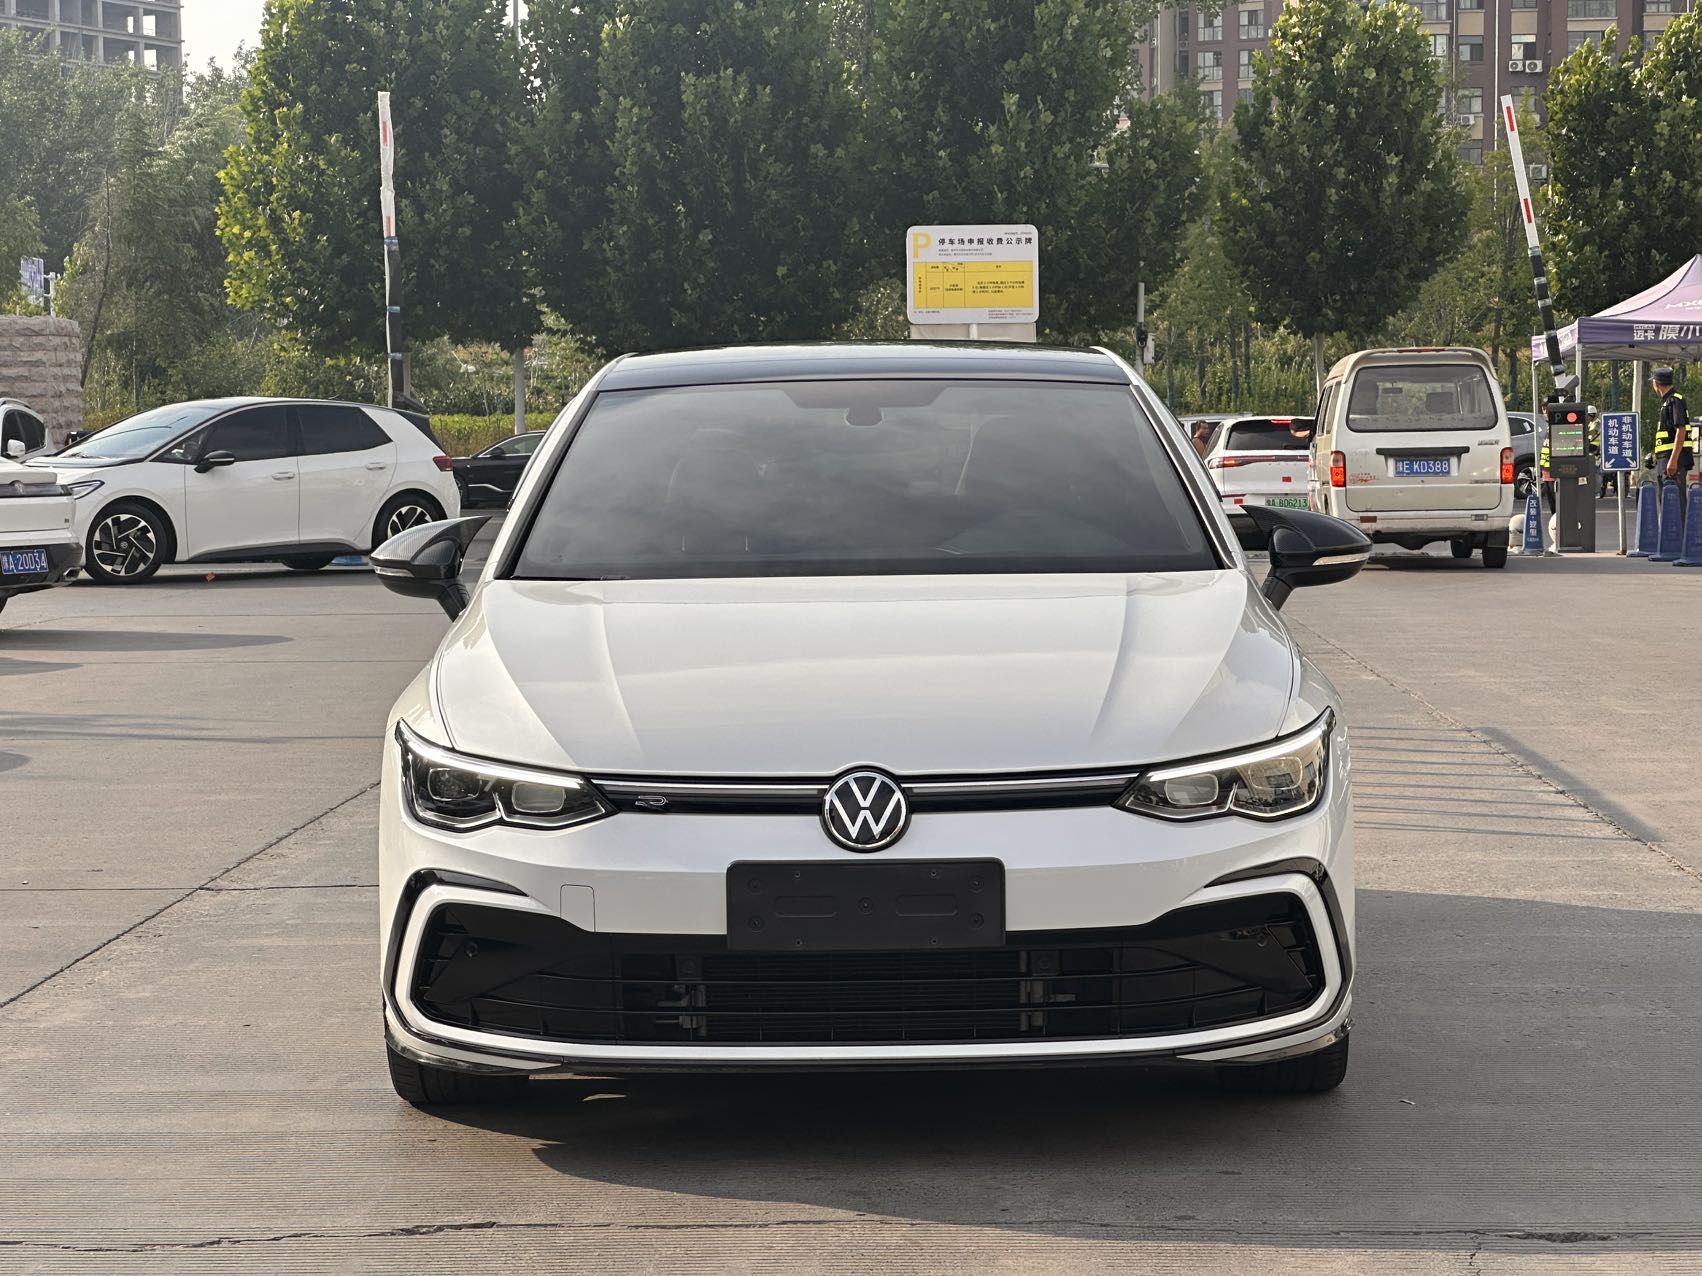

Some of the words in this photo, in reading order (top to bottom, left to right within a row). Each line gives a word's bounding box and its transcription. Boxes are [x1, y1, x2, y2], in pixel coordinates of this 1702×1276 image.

[912, 233, 932, 259] P
[938, 237, 1033, 246] 停车场申报收费公示牌
[1633, 329, 1655, 340] 迈卡
[1607, 418, 1619, 455] 机动车道
[1621, 415, 1633, 457] 非机动车道
[826, 773, 905, 844] VW
